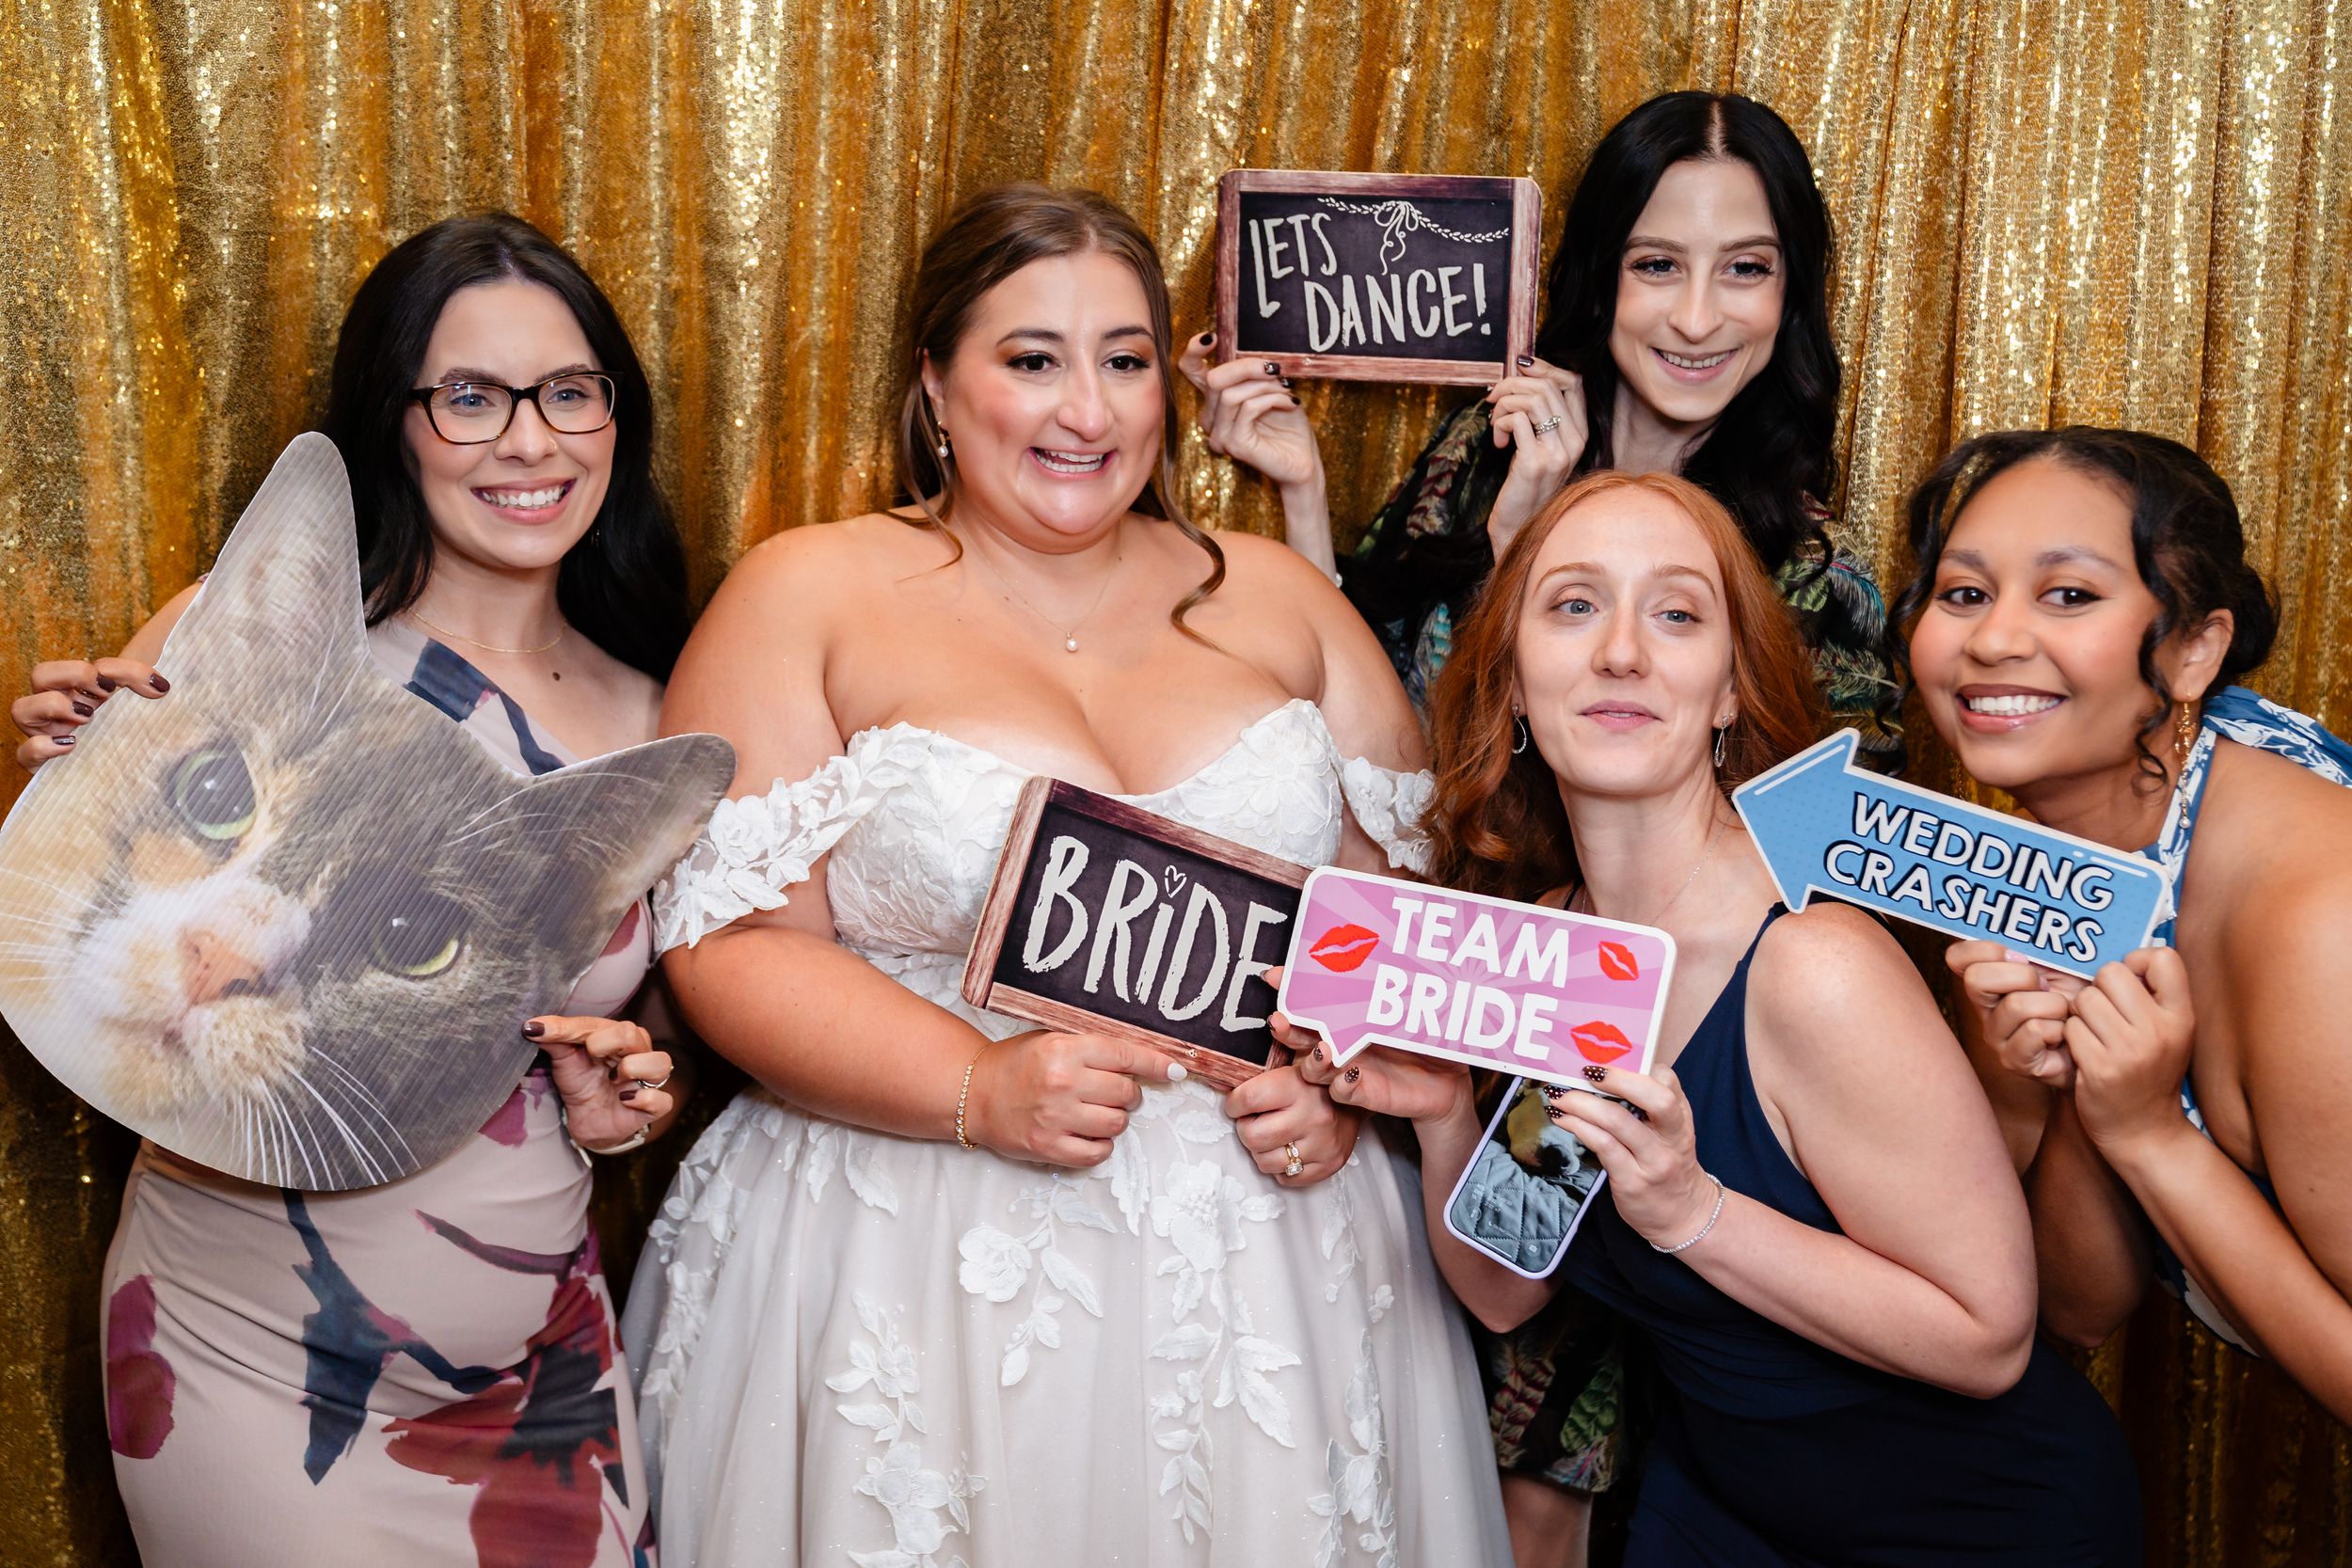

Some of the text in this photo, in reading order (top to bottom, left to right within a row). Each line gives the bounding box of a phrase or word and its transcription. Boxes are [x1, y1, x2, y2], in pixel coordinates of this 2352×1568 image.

[1249, 213, 1337, 319] LETS
[1304, 263, 1491, 352] DANCE!
[1824, 840, 2105, 963] CRASHERS
[1852, 791, 2114, 911] WEDDING
[1391, 895, 1570, 989] TEAM
[1366, 964, 1559, 1060] BRIDE
